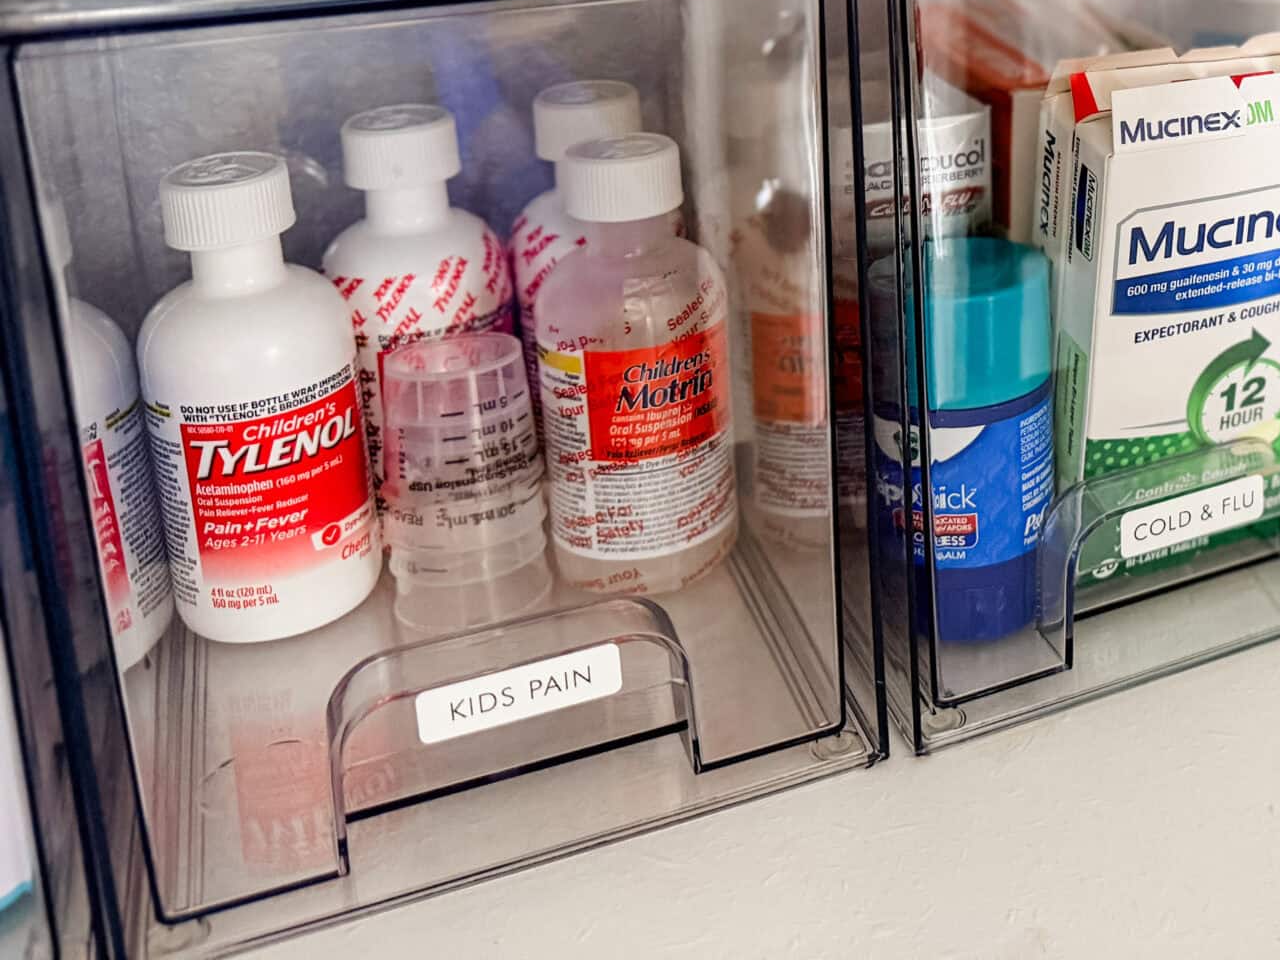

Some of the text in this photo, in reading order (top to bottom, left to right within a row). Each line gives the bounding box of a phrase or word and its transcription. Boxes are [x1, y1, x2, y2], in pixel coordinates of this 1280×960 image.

[1119, 109, 1241, 145] Mucinex
[1039, 130, 1057, 236] Mucinex
[1127, 284, 1148, 297] 600
[1150, 281, 1168, 295] mg
[1170, 269, 1230, 290] guaifenesin
[1231, 265, 1240, 277] &
[1242, 262, 1256, 274] 30
[1257, 259, 1273, 274] mg
[1175, 274, 1263, 302] extended-release
[667, 298, 704, 332] Sealed
[1134, 314, 1225, 345] EXPECTORANT
[1227, 311, 1237, 324] &
[1240, 301, 1280, 321] COUGH
[180, 405, 194, 414] DO
[195, 405, 215, 415] NOT
[217, 405, 238, 414] USE
[239, 403, 249, 411] IF
[251, 393, 289, 410] BOTTLE
[291, 383, 318, 399] WRAP
[183, 414, 207, 423] WITH
[267, 405, 277, 415] IS
[279, 391, 317, 412] BROKEN
[318, 387, 329, 399] OR
[473, 395, 508, 415] 5 mL
[616, 367, 714, 413] Motrin
[1220, 376, 1267, 412] 12
[243, 402, 337, 441] Children's
[500, 418, 515, 432] 10
[610, 413, 692, 436] Oral Suspension
[1219, 406, 1264, 431] HOUR
[189, 407, 356, 480] TYLENOL
[645, 433, 659, 446] per
[662, 431, 666, 441] 5
[196, 478, 273, 496] Acetaminophen
[275, 476, 296, 488] (160
[297, 471, 310, 483] mg
[311, 466, 323, 478] per
[324, 463, 329, 472] 5
[197, 494, 263, 508] Oral Suspension
[199, 508, 215, 517] Pain
[276, 493, 309, 509] Reducer
[1133, 510, 1192, 542] COLD
[1200, 504, 1213, 522] &
[1222, 491, 1255, 515] FLU
[205, 524, 307, 549] Ages 2-11 Years
[211, 584, 273, 599] 4 fl oz (120 mL)
[212, 598, 226, 609] 160
[227, 598, 241, 610] mg
[242, 596, 257, 610] per
[258, 595, 265, 606] 5
[450, 665, 592, 722] KIDS PAIN
